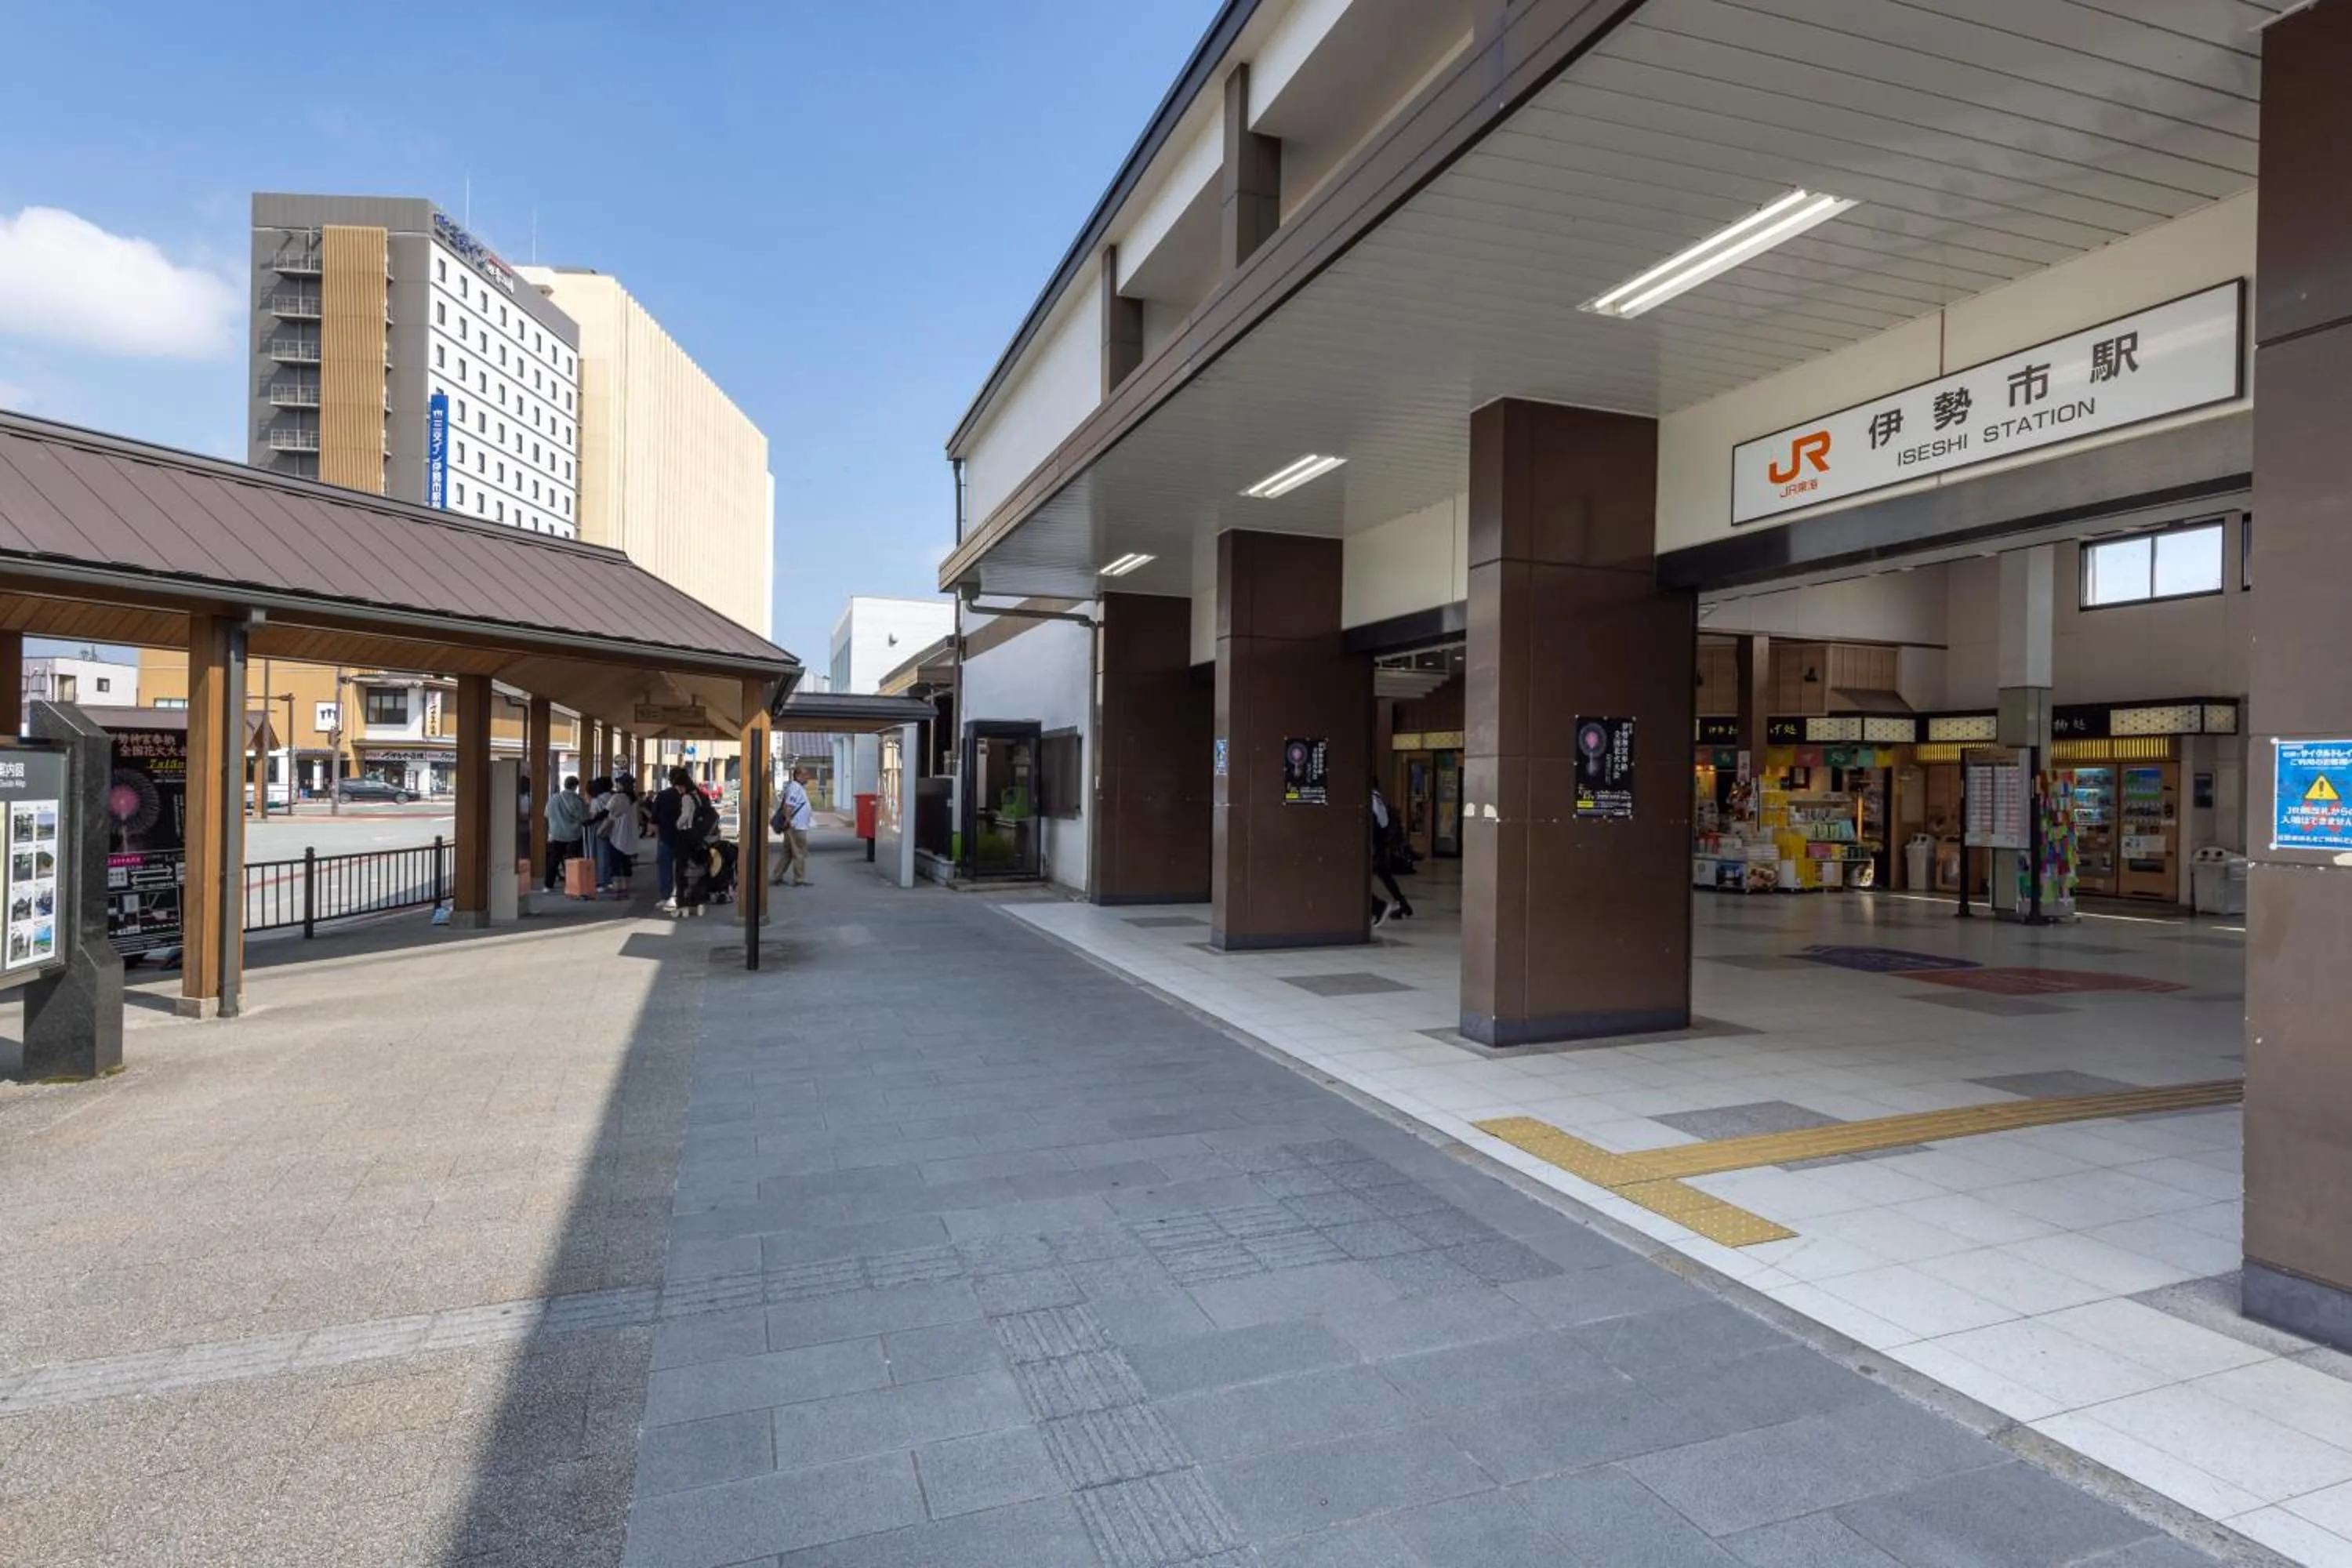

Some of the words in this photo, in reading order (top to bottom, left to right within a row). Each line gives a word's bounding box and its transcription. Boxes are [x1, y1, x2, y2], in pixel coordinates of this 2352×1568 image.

[1869, 332, 2139, 449] 伊勢市駅
[1769, 430, 1831, 484] JR
[1897, 437, 1968, 466] ISESHI
[1983, 397, 2096, 443] STATION
